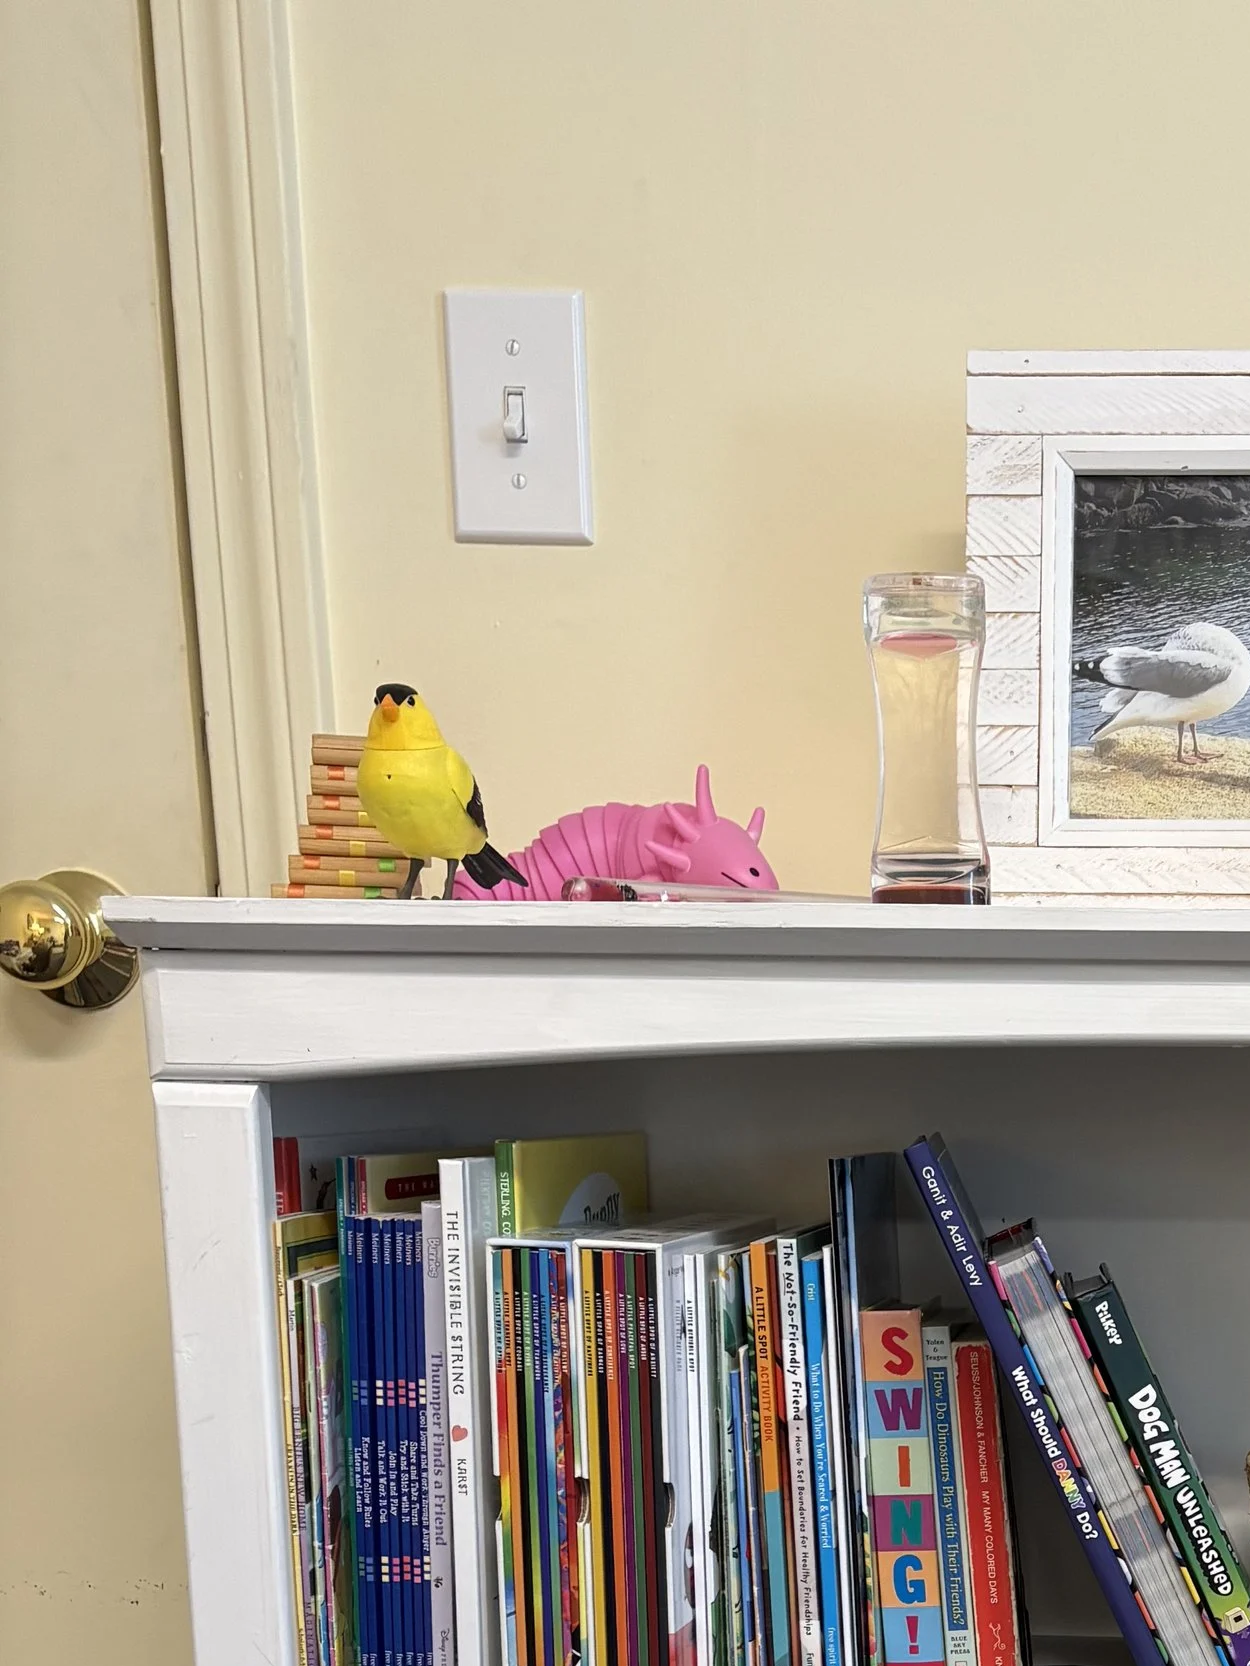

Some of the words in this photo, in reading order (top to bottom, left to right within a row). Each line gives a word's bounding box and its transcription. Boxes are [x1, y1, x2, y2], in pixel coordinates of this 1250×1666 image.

[921, 1165, 947, 1207] Ganit
[446, 1211, 459, 1241] THE
[940, 1209, 954, 1221] &
[356, 1232, 364, 1264] Meiners
[371, 1232, 380, 1264] Meiners
[383, 1233, 392, 1265] Meiners
[395, 1231, 404, 1263] Meiners
[405, 1234, 413, 1266] Meiners
[946, 1224, 968, 1252] Adir
[427, 1237, 440, 1279] Bunnies
[782, 1243, 795, 1267] The
[961, 1254, 984, 1288] Levy
[447, 1247, 462, 1329] INVISIBLE
[755, 1286, 766, 1294] A
[807, 1283, 816, 1302] Crist
[755, 1296, 767, 1332] LITTLE
[782, 1272, 802, 1376] Not-So-Friendly
[757, 1334, 768, 1361] SPOT
[450, 1335, 464, 1395] STRING
[810, 1362, 821, 1387] What
[430, 1351, 444, 1428] Thumper
[760, 1365, 772, 1413] ACTIVITY
[812, 1389, 822, 1399] to
[932, 1371, 945, 1397] How
[791, 1381, 803, 1422] Friend
[812, 1401, 823, 1413] Do
[935, 1402, 948, 1419] Do
[762, 1415, 774, 1442] BOOK
[814, 1416, 825, 1440] When
[969, 1351, 985, 1430] SEUSS/JOHNSON
[977, 1440, 989, 1484] FANCHER
[361, 1436, 370, 1459] Know
[399, 1439, 408, 1454] Try
[794, 1435, 803, 1454] How
[1127, 1383, 1170, 1441] DOG
[1149, 1438, 1191, 1489] MAN
[400, 1456, 409, 1471] and
[409, 1441, 418, 1463] Share
[433, 1433, 446, 1476] Finds
[795, 1458, 804, 1467] to
[815, 1442, 827, 1471] You're
[937, 1423, 951, 1482] Dinosaurs
[1011, 1365, 1039, 1408] What
[1029, 1408, 1062, 1460] Should
[1051, 1458, 1087, 1511] DANNY
[1075, 1510, 1099, 1541] Do?
[362, 1460, 371, 1476] and
[378, 1460, 386, 1475] and
[456, 1458, 468, 1496] KARST
[796, 1469, 805, 1484] Set
[363, 1477, 372, 1504] Follow
[378, 1477, 387, 1498] Work
[389, 1481, 398, 1496] and
[434, 1480, 444, 1489] a
[816, 1473, 830, 1502] Scared
[941, 1486, 955, 1510] Play
[981, 1490, 990, 1505] MY
[389, 1498, 398, 1516] Play
[434, 1495, 447, 1546] Friend
[796, 1486, 806, 1532] Boundaries
[820, 1505, 830, 1513] &
[982, 1507, 997, 1533] MANY
[820, 1514, 832, 1549] Worried
[943, 1511, 957, 1537] with
[799, 1536, 809, 1549] for
[800, 1551, 811, 1584] Healthy
[946, 1542, 960, 1574] Their
[984, 1535, 997, 1579] COLORED
[948, 1577, 965, 1625] Friends?
[989, 1580, 998, 1604] DAYS
[802, 1586, 813, 1636] Friendships
[827, 1627, 836, 1642] free
[827, 1644, 837, 1664] spirit
